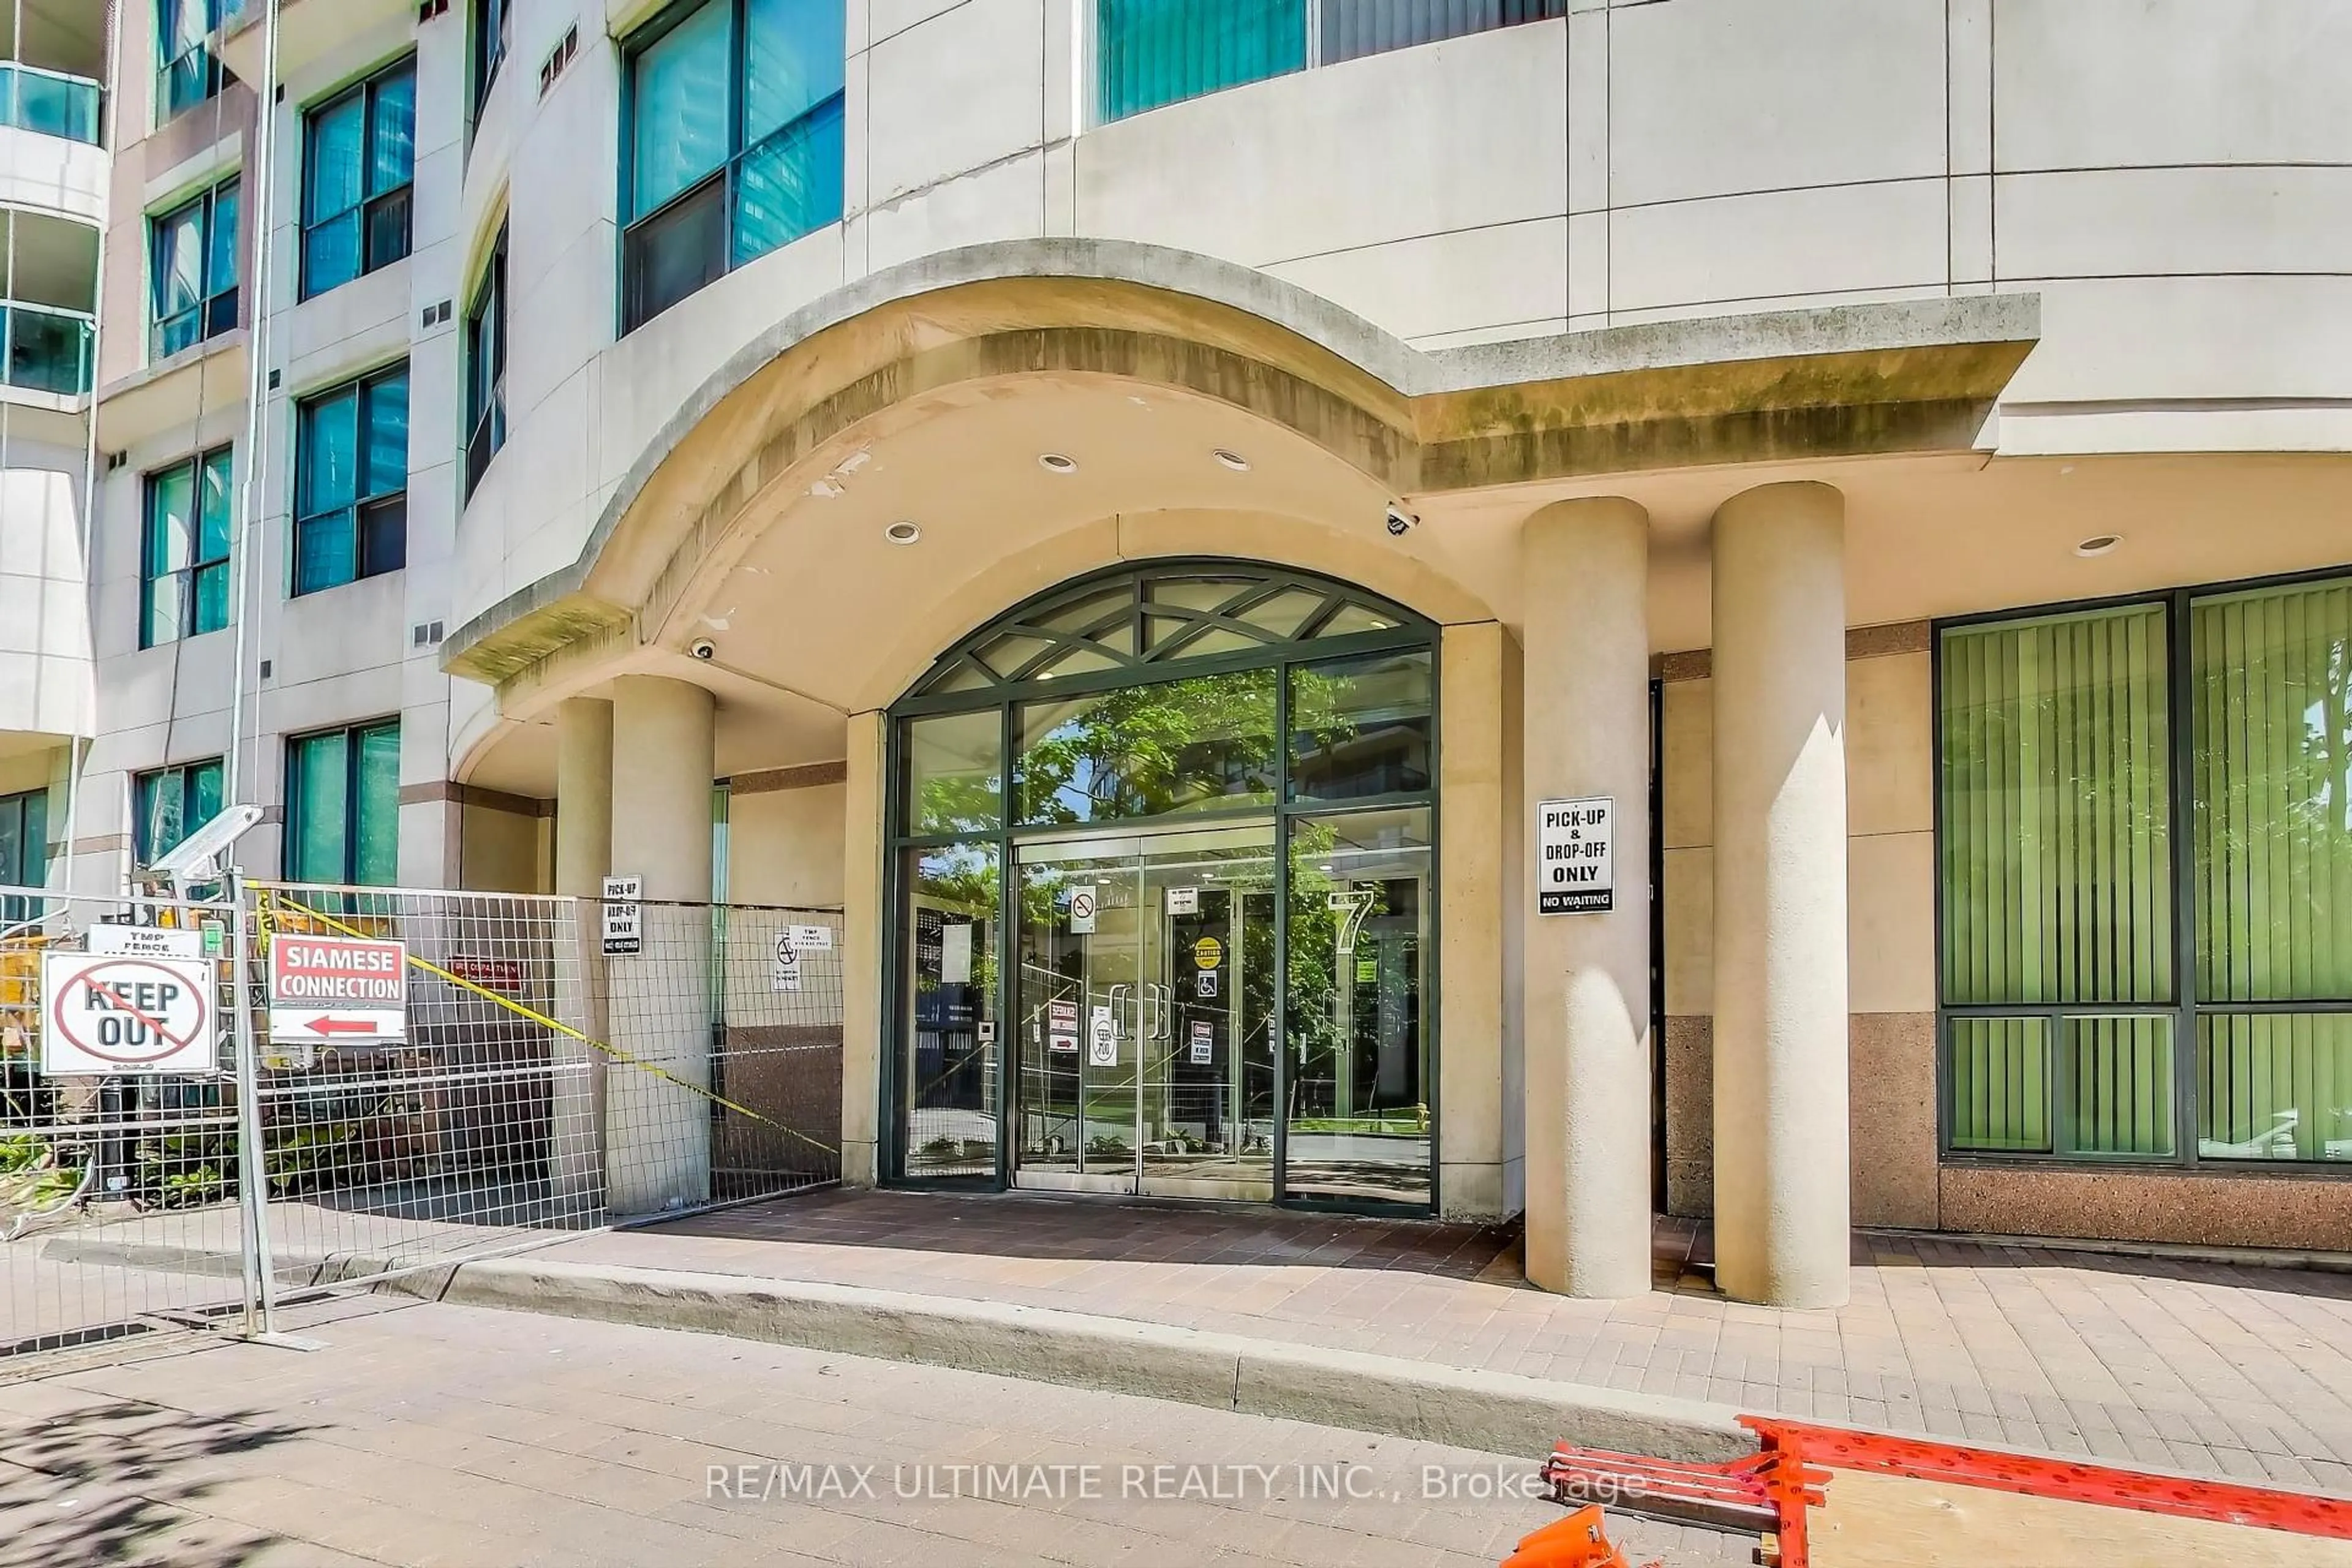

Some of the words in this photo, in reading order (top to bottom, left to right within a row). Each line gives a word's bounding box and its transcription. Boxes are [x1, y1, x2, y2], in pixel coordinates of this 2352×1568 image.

[1547, 809, 1605, 827] PICK-UP
[1570, 829, 1580, 839] &
[1546, 842, 1606, 860] DROP-OFF
[1553, 865, 1598, 883] ONLY
[1543, 897, 1559, 907] NO
[1563, 894, 1609, 907] WAITING
[610, 922, 632, 932] ONLY
[1328, 891, 1374, 954] 7
[124, 943, 169, 952] FENCE
[287, 946, 394, 972] SIAMESE
[281, 975, 399, 998] CONNECTION
[85, 981, 179, 1011] KEEP
[98, 1016, 169, 1046] OUT
